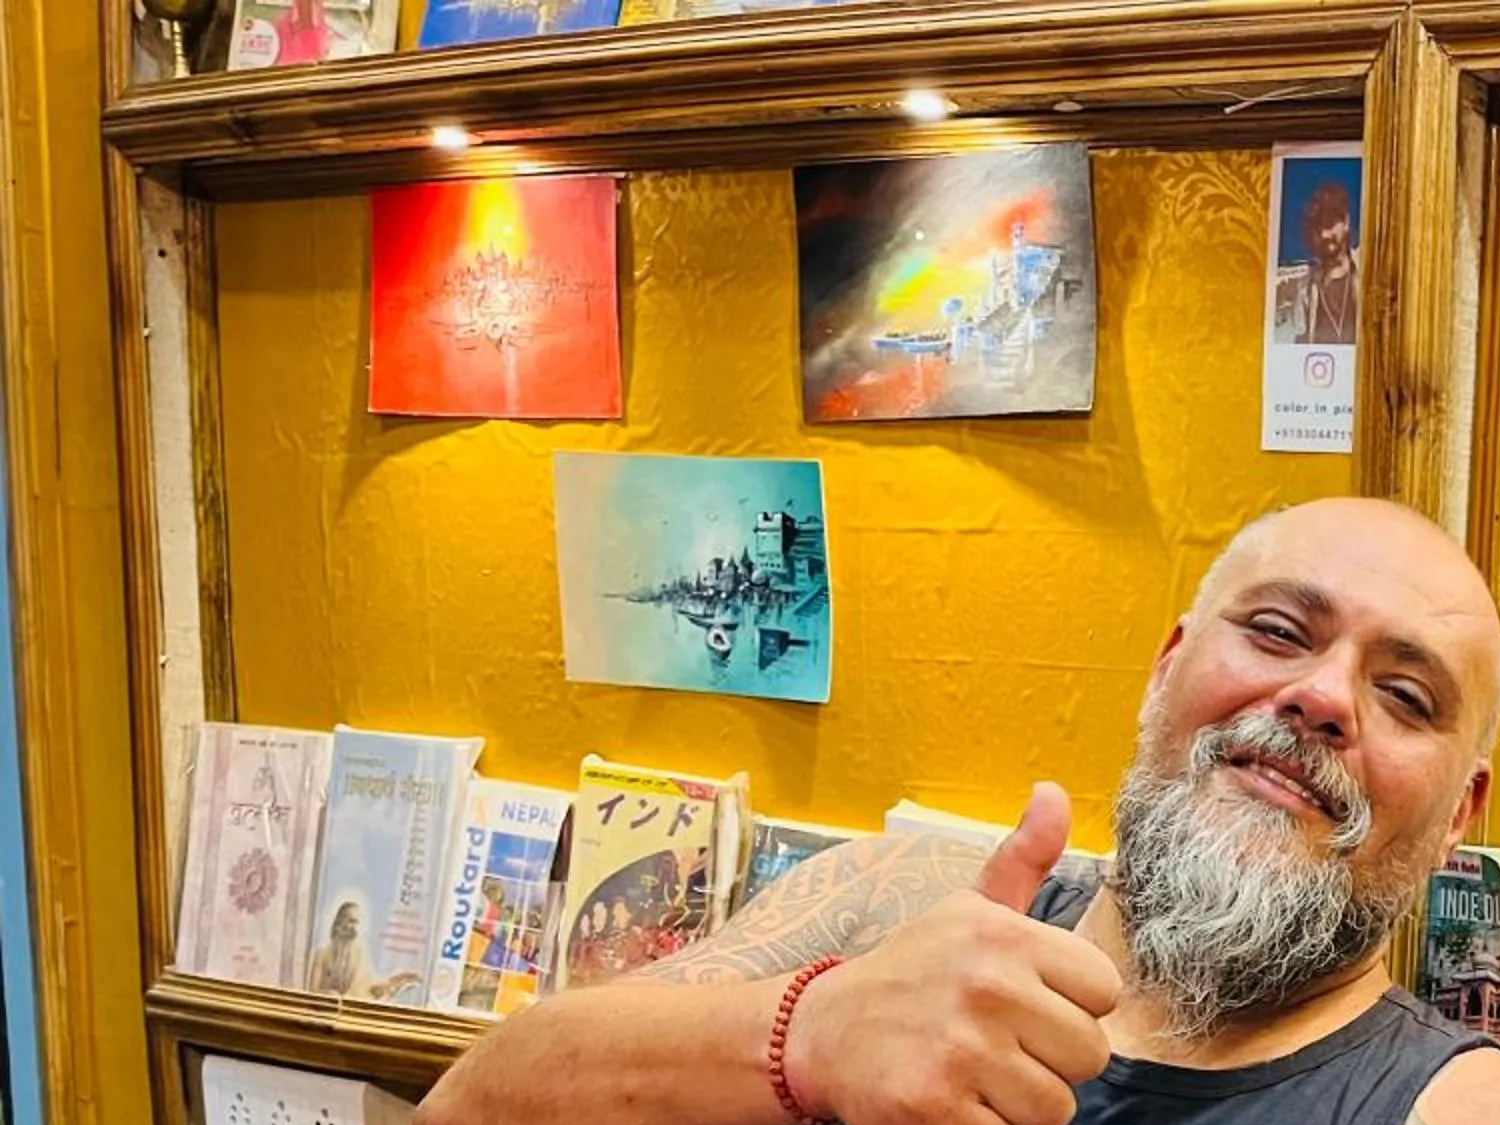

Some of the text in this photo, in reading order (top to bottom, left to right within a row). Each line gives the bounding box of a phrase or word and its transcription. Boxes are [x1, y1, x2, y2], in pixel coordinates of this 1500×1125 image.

[500, 801, 557, 828] NEPAL
[597, 793, 700, 837] インド
[441, 826, 486, 961] Routard
[1440, 886, 1480, 922] INDE
